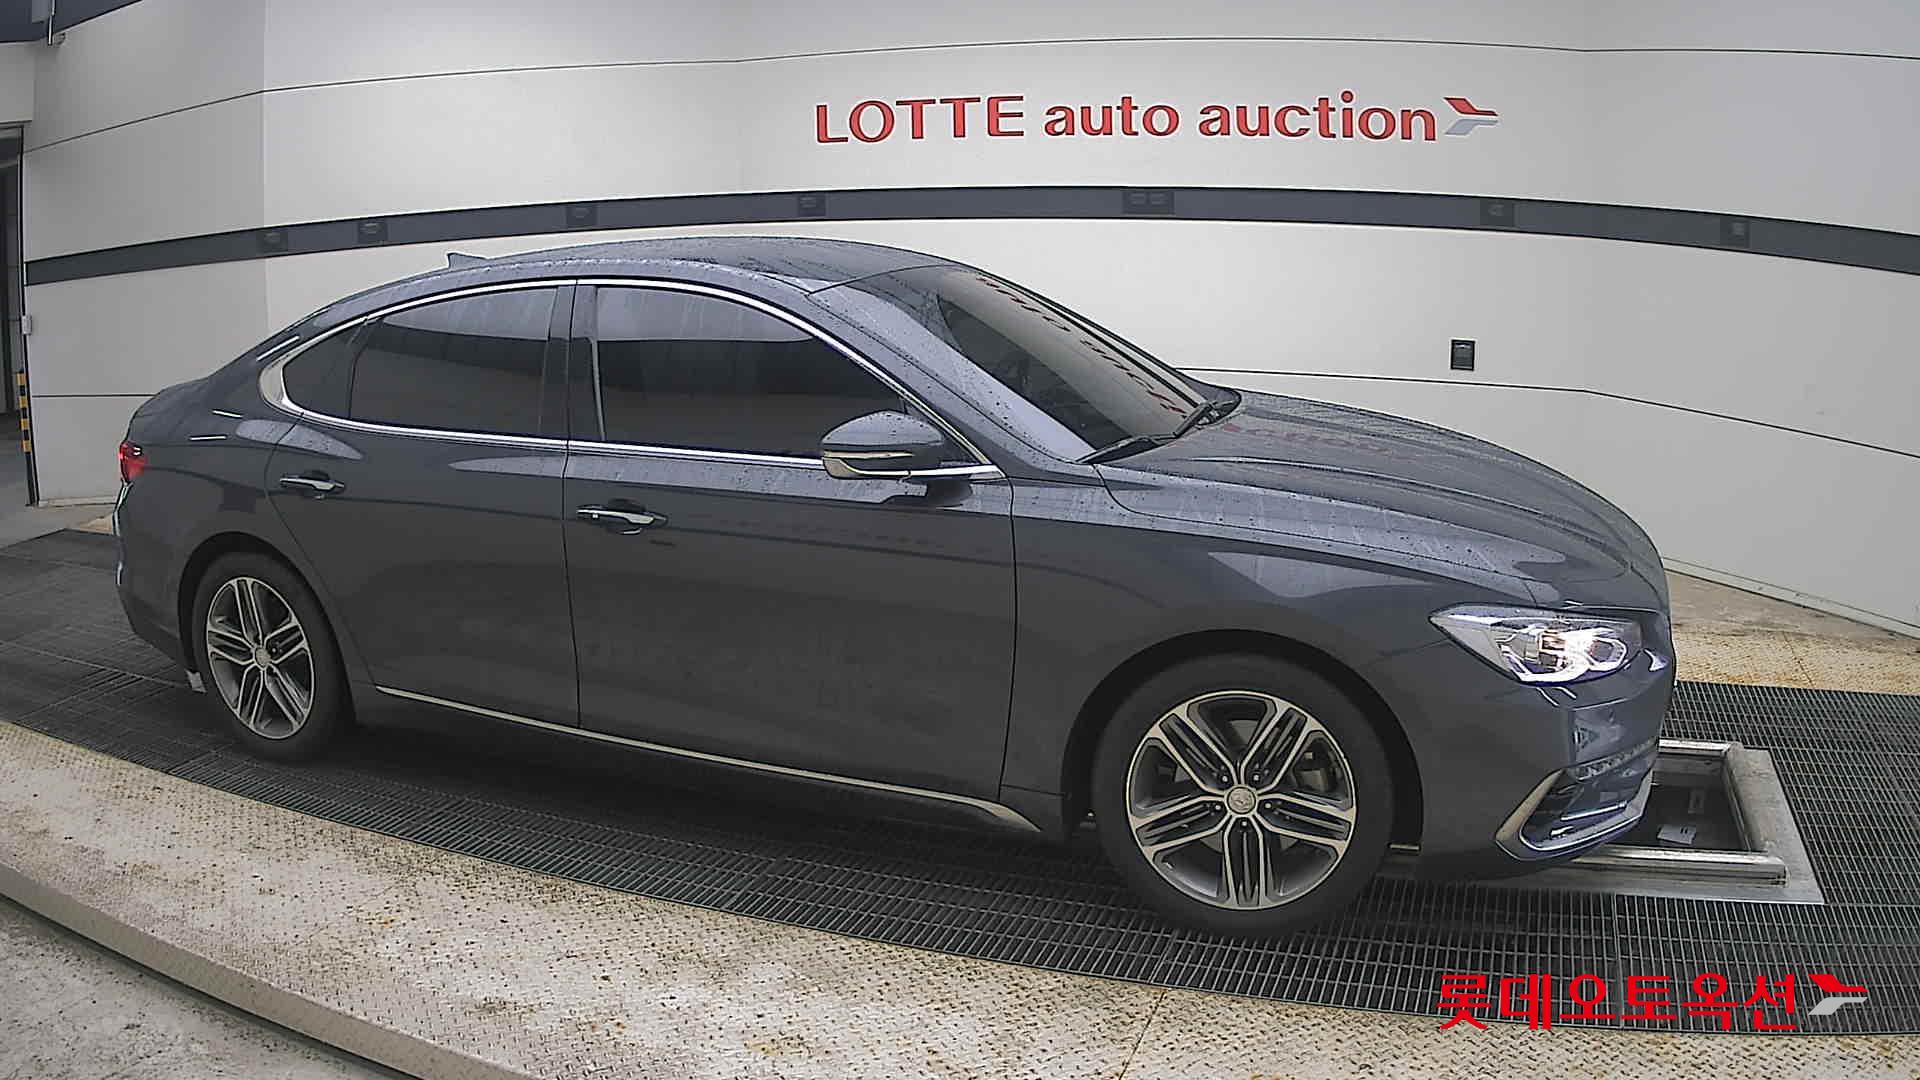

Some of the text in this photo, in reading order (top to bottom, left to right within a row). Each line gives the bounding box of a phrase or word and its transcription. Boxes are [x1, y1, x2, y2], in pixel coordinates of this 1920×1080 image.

[815, 91, 1437, 143] LOTTE auto auction
